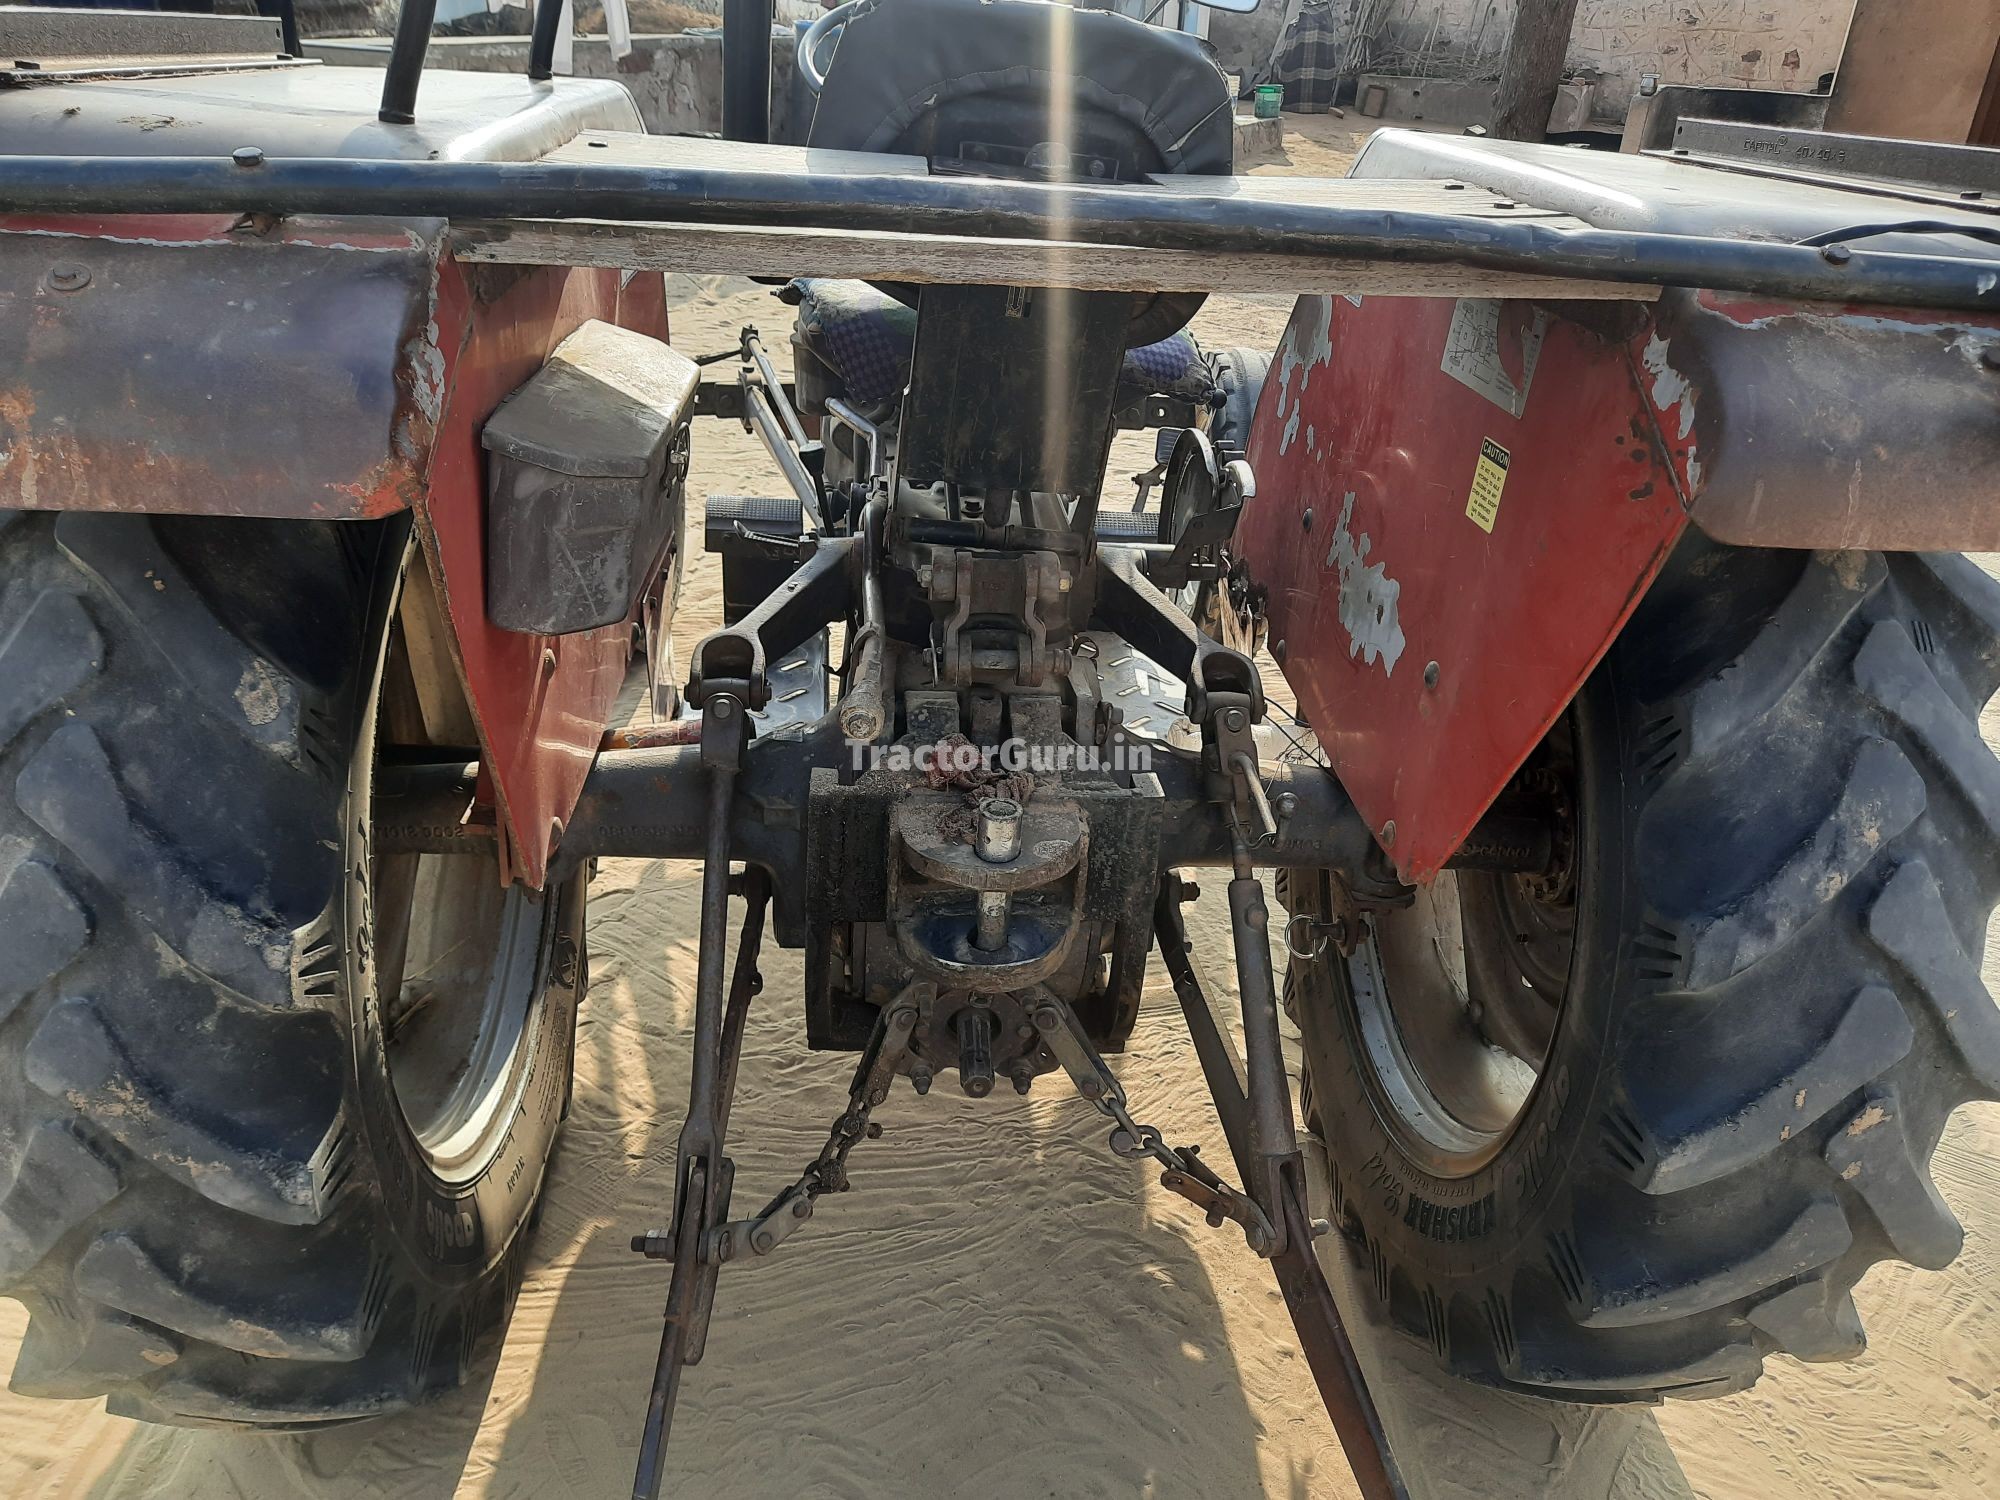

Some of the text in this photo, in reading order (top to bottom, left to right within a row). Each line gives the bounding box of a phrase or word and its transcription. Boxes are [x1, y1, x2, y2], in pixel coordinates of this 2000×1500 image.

[1744, 138, 1781, 154] CAPITAL
[1483, 442, 1508, 467] CAUTION
[1403, 1192, 1496, 1243] KRISHAK
